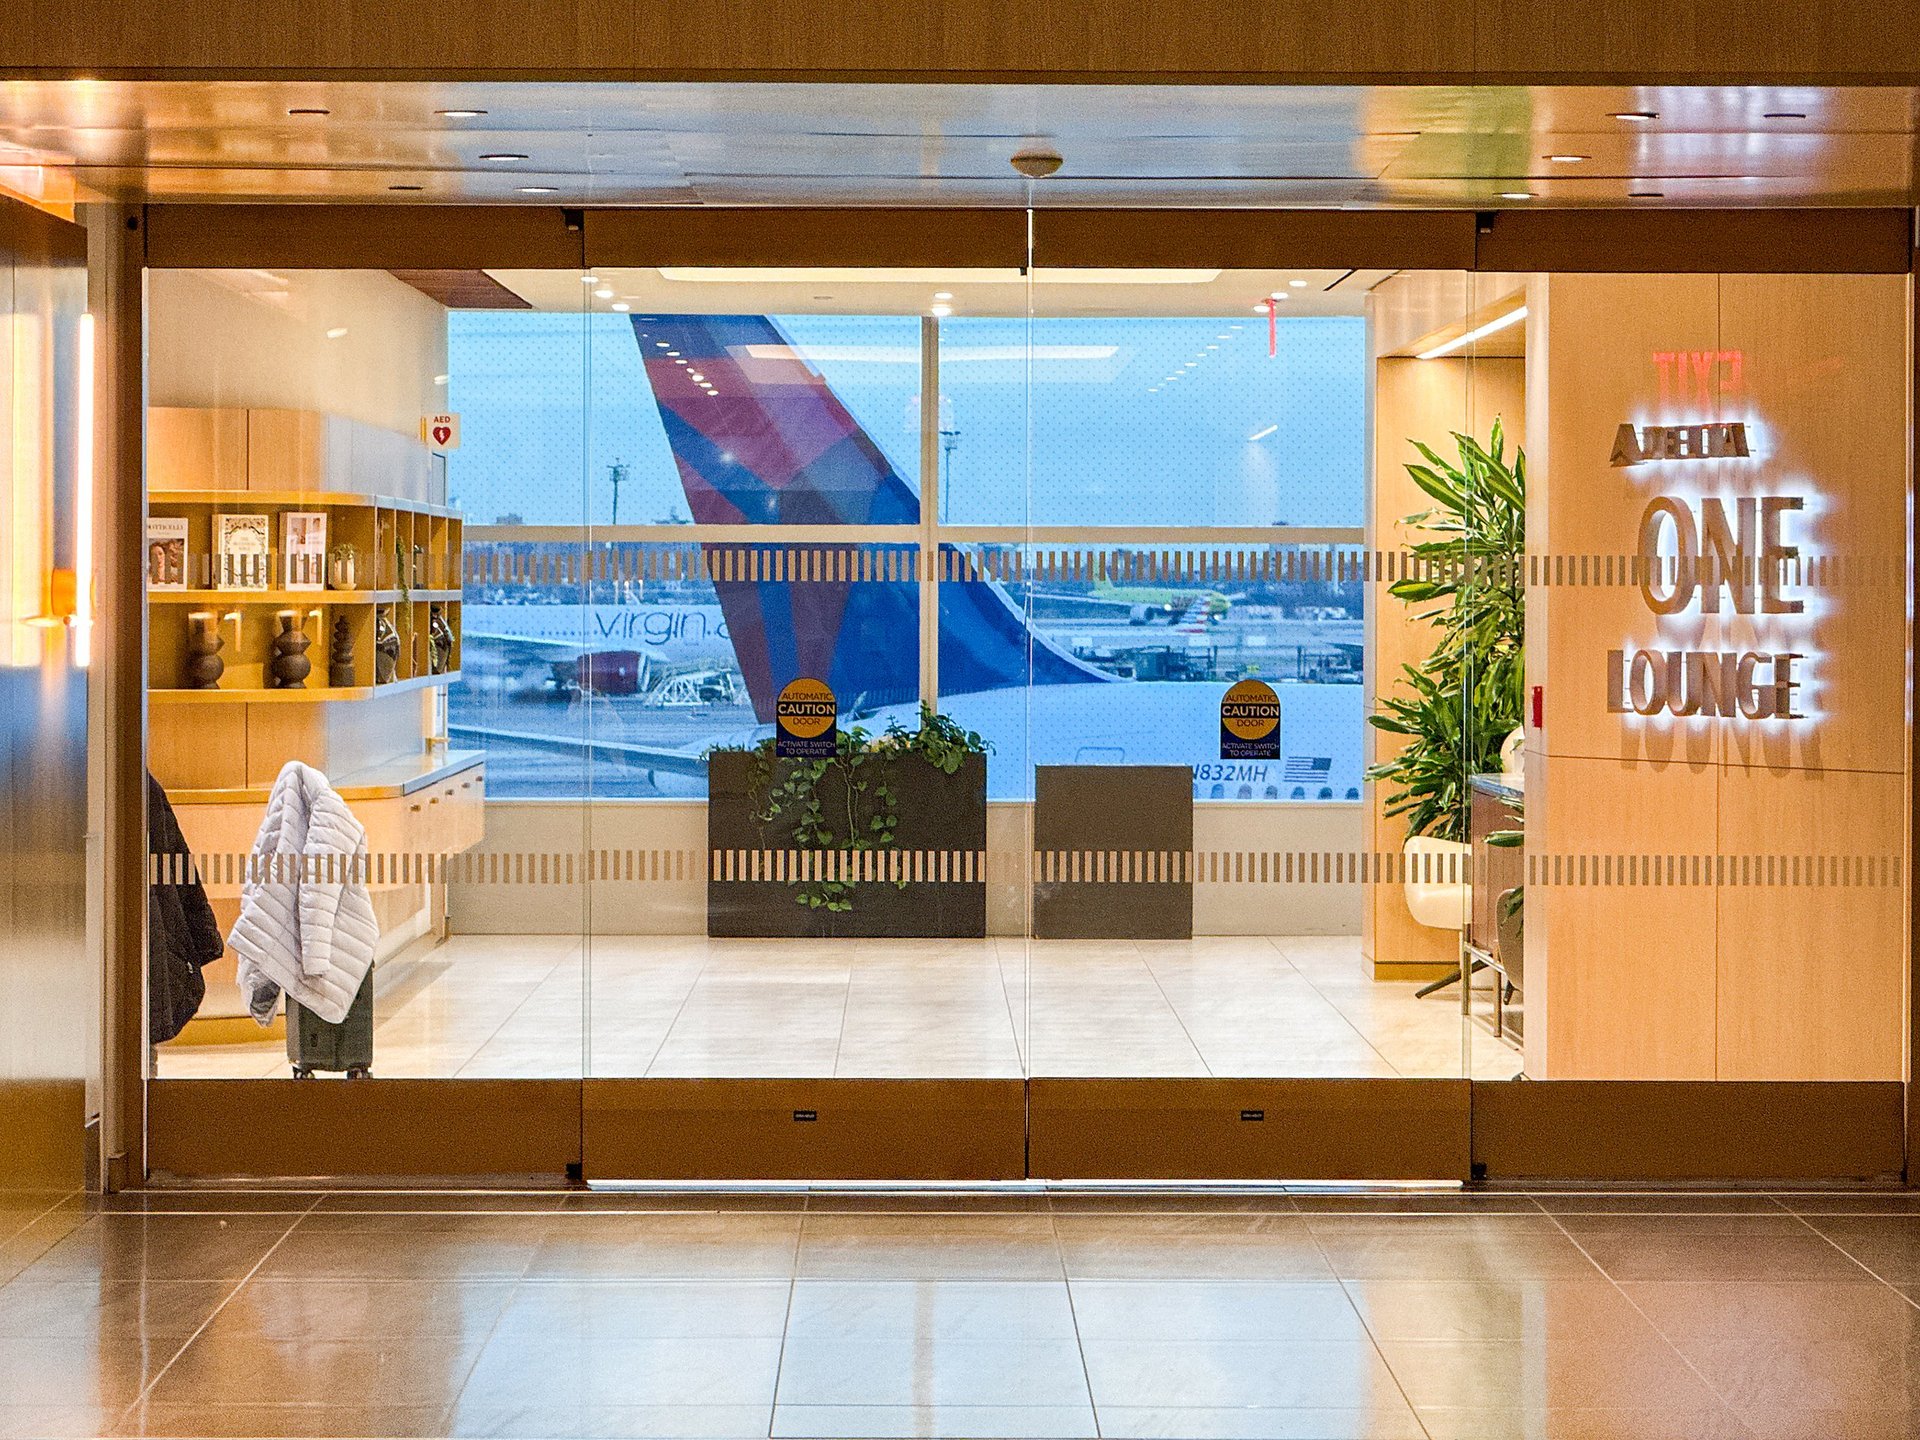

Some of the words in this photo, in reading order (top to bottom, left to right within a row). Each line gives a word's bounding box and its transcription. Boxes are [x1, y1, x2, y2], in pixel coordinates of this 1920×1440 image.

[433, 415, 451, 423] AED
[1637, 496, 1804, 615] ONE
[595, 608, 707, 646] virgin
[1607, 649, 1804, 720] LOUNGE
[782, 692, 833, 701] AUTOMATIC
[1226, 694, 1277, 703] AUTOMATIC
[778, 704, 836, 715] CAUTION
[1222, 705, 1279, 716] CAUTION
[793, 717, 821, 726] DOOR
[1237, 719, 1265, 728] DOOR
[778, 740, 808, 748] ACTIVATE
[1222, 742, 1252, 750] ACTIVATE
[1254, 742, 1279, 750] SWITCH
